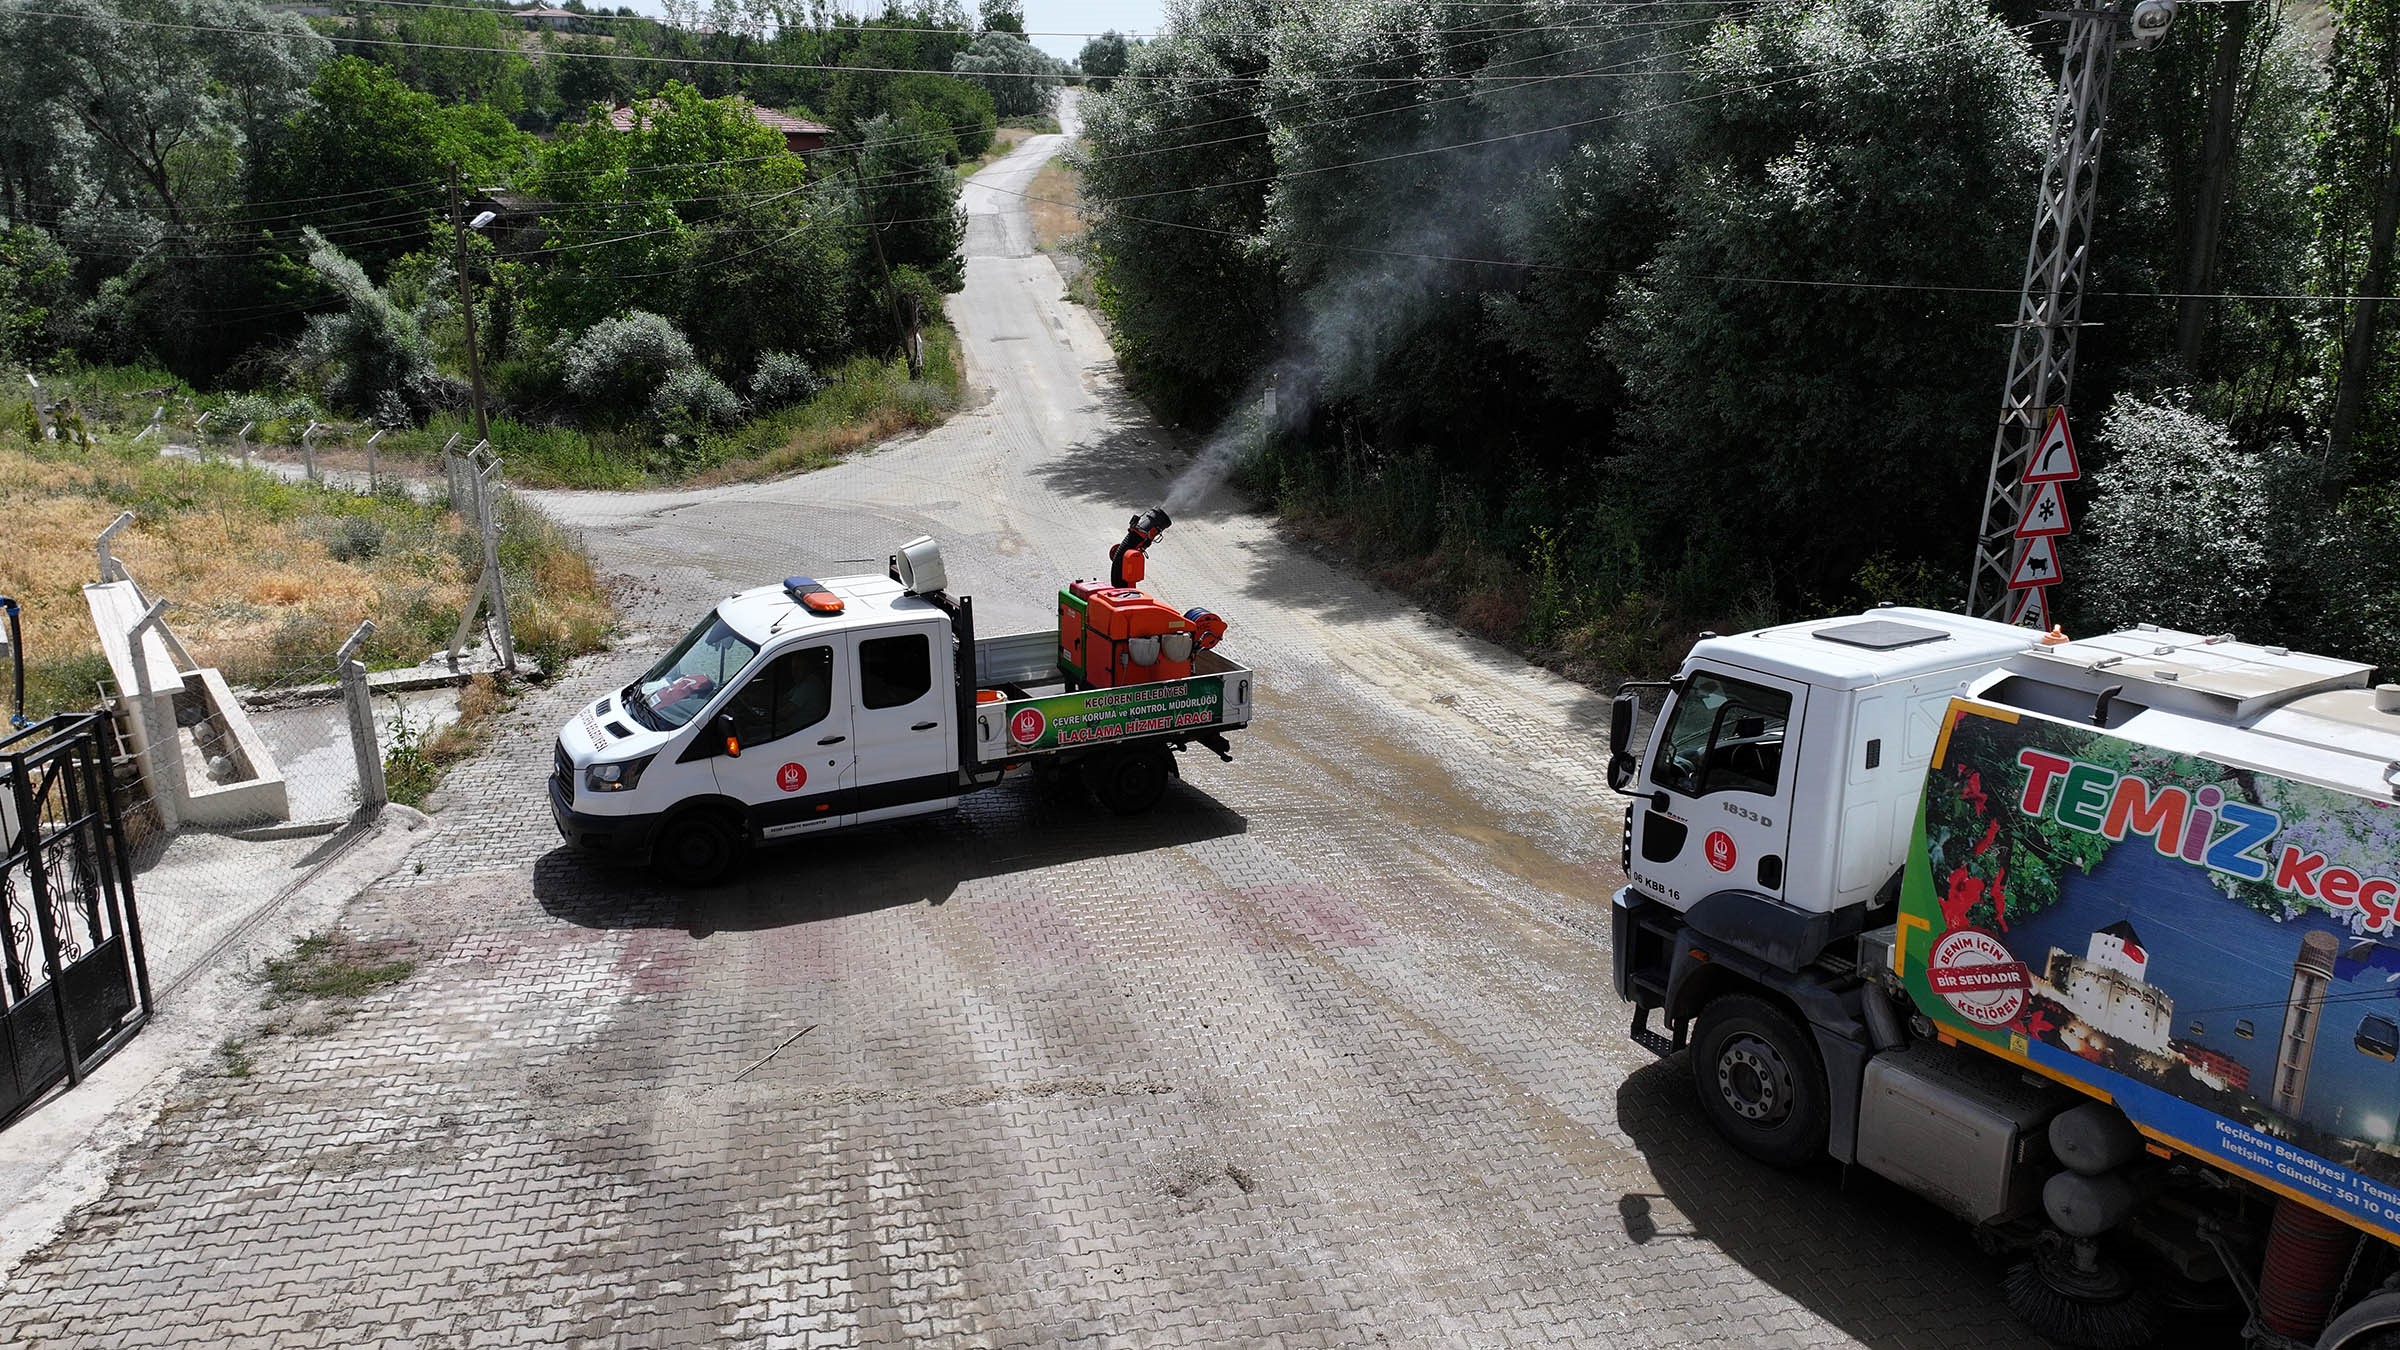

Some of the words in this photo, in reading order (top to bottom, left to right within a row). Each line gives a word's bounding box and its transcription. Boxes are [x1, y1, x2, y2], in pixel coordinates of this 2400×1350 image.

[1136, 683, 1188, 701] BELEDİYESİ
[1052, 715, 1080, 728] ÇEVRE
[1082, 710, 1116, 722] KORUMA
[1130, 703, 1166, 716] KONTROL
[1168, 694, 1217, 710] MÜDÜRLÜĞÜ
[1058, 724, 1123, 744] İLAÇLAMA
[1126, 716, 1173, 734] HİZMET
[1175, 710, 1212, 726] ARACI
[1722, 802, 1758, 822] 1833
[1633, 871, 1643, 884] 06
[1645, 878, 1665, 894] KBB
[1668, 888, 1680, 900] 16
[2274, 843, 2400, 933] Keç
[1941, 938, 1973, 965] BENİM
[1976, 937, 2004, 961] İÇİN
[1937, 973, 1958, 987] BİR
[1959, 972, 2022, 986] SEVDADIR
[1958, 996, 2019, 1020] KEÇİÖREN
[2215, 1120, 2272, 1151] Keçiören
[2275, 1145, 2345, 1183] Belediyesi
[2222, 1136, 2273, 1168] İletişim:
[2276, 1162, 2332, 1194] Gündüz:
[2336, 1187, 2360, 1206] 361
[2362, 1199, 2380, 1214] 10
